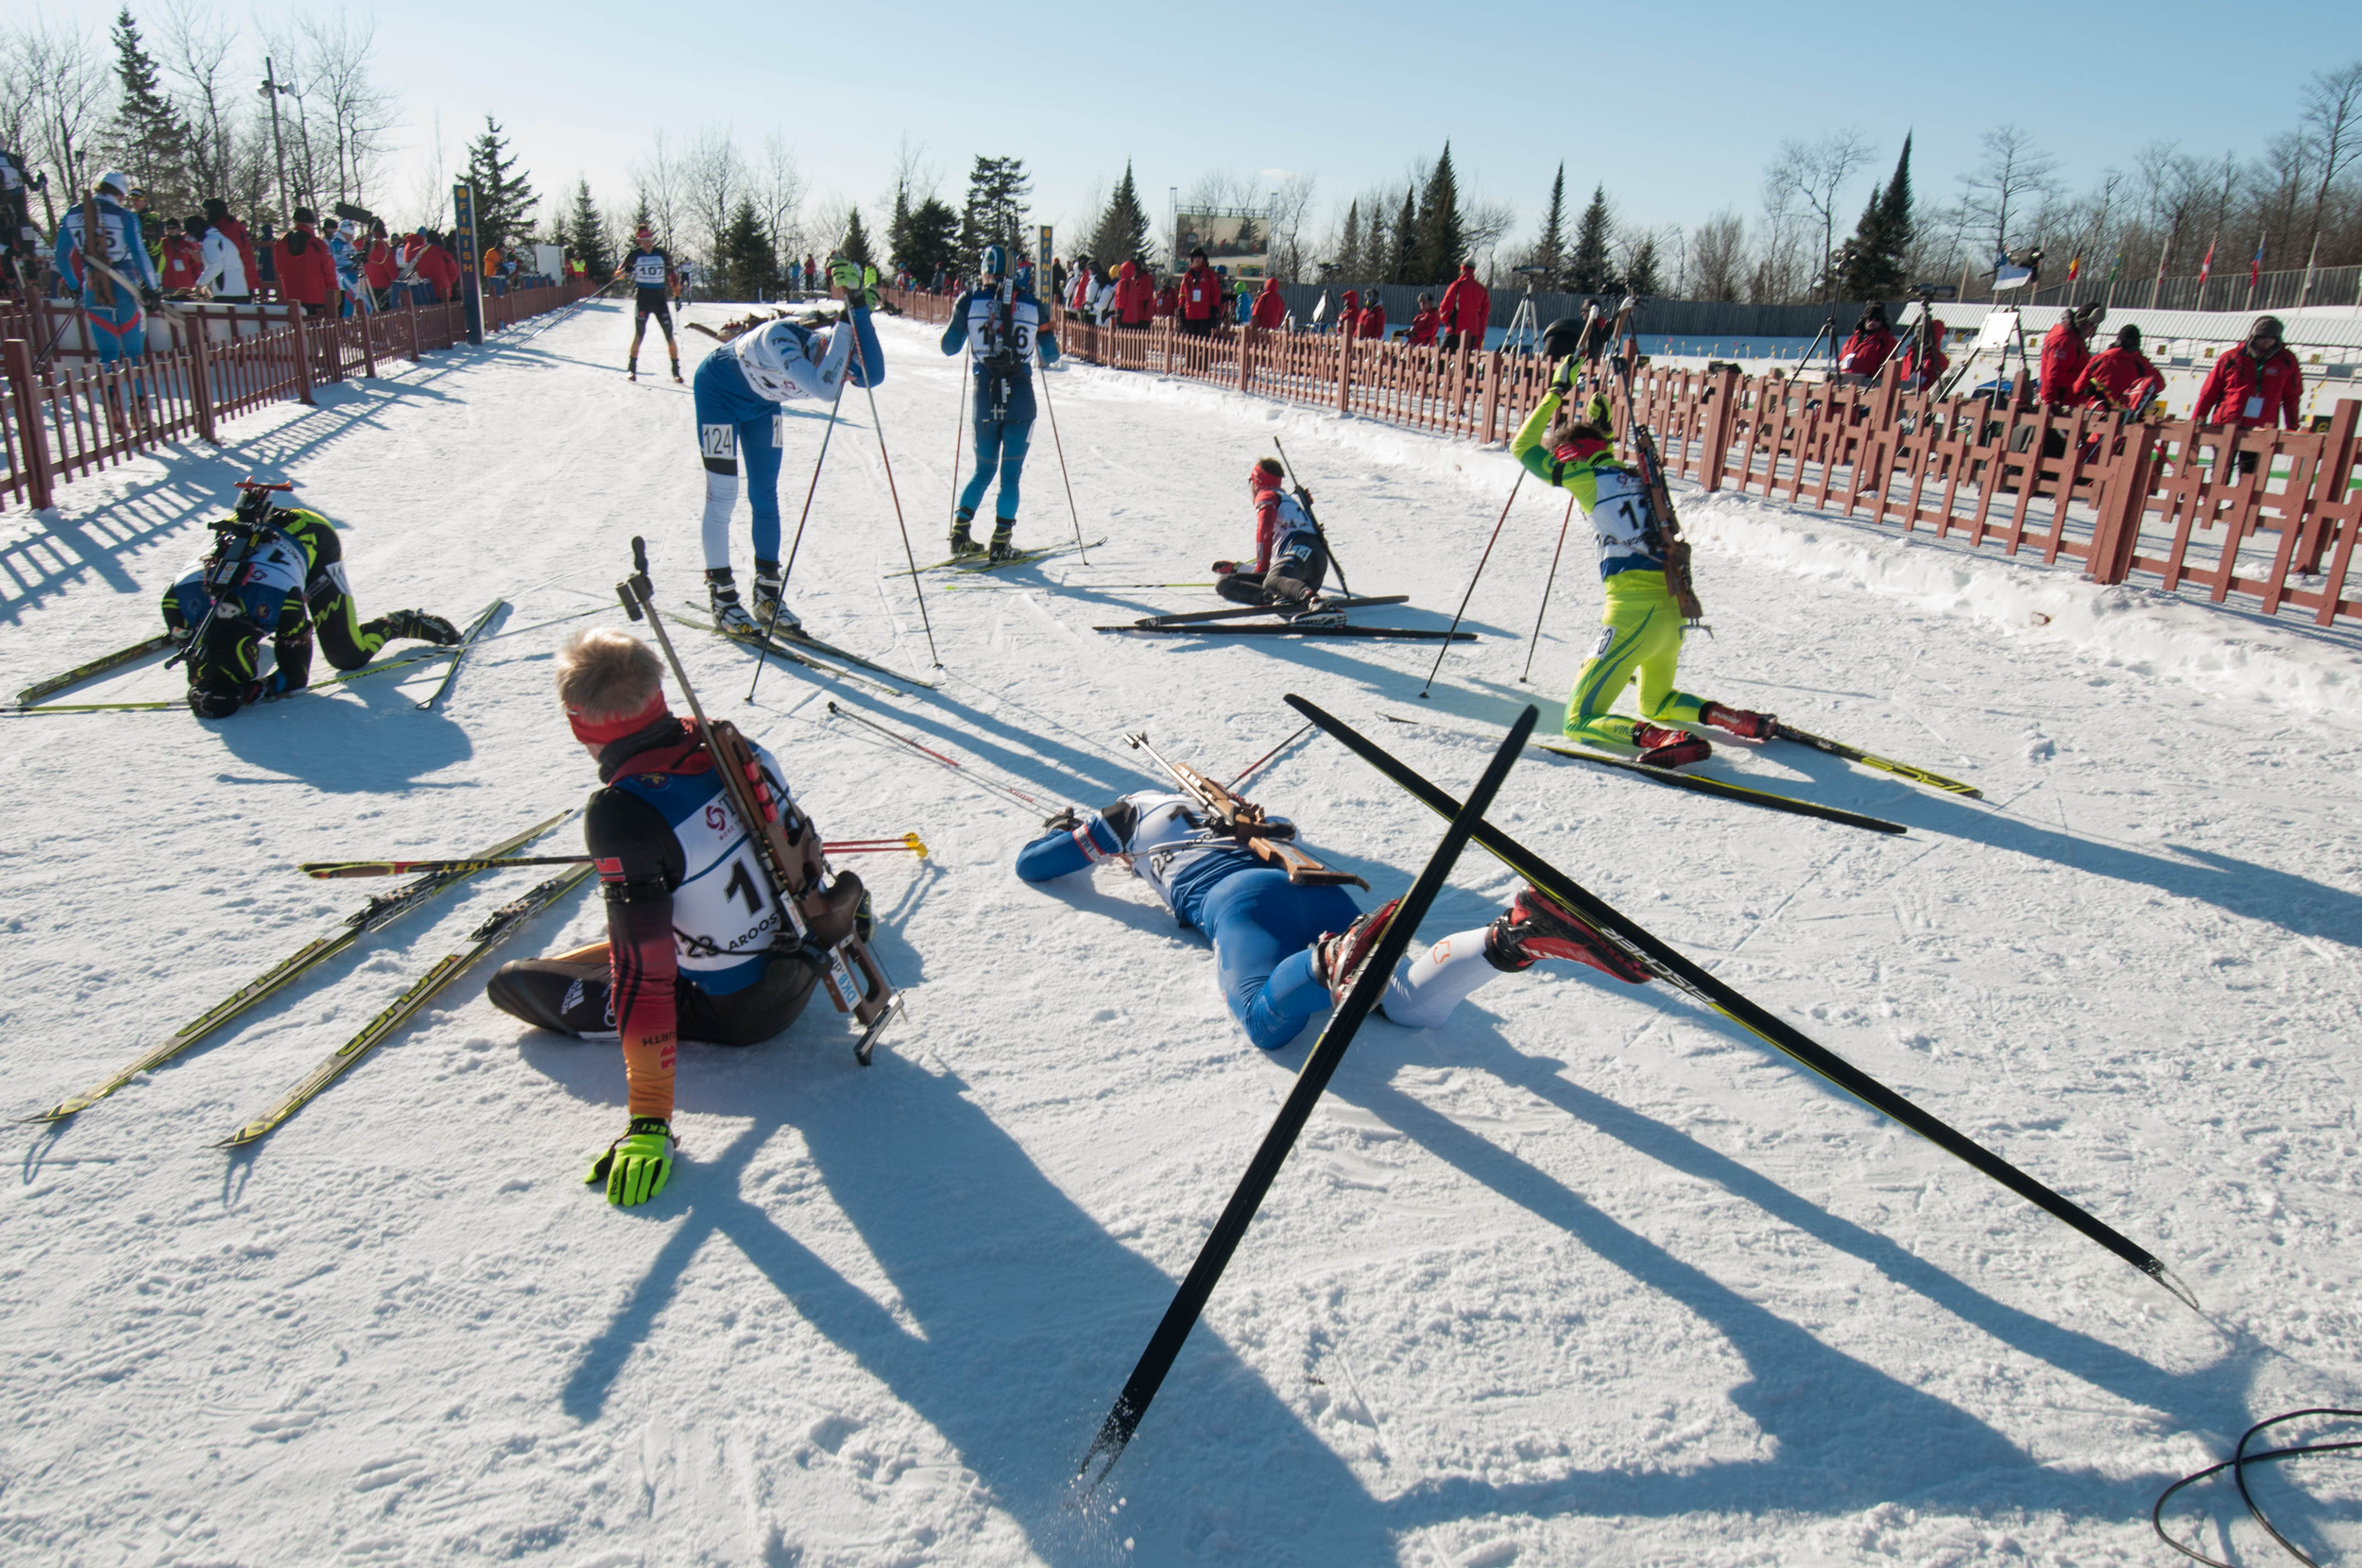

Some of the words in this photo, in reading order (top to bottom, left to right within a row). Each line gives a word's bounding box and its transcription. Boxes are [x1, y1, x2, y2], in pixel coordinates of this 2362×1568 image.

[458, 201, 473, 273] FINISH
[639, 266, 664, 276] 107
[1041, 241, 1051, 304] FINISH
[977, 323, 1029, 349] 16
[703, 427, 732, 454] 124
[442, 861, 489, 872] LEKI
[365, 885, 436, 931] FISCHER
[489, 898, 548, 946] FISCHER
[1600, 926, 1718, 1004] FISCHER
